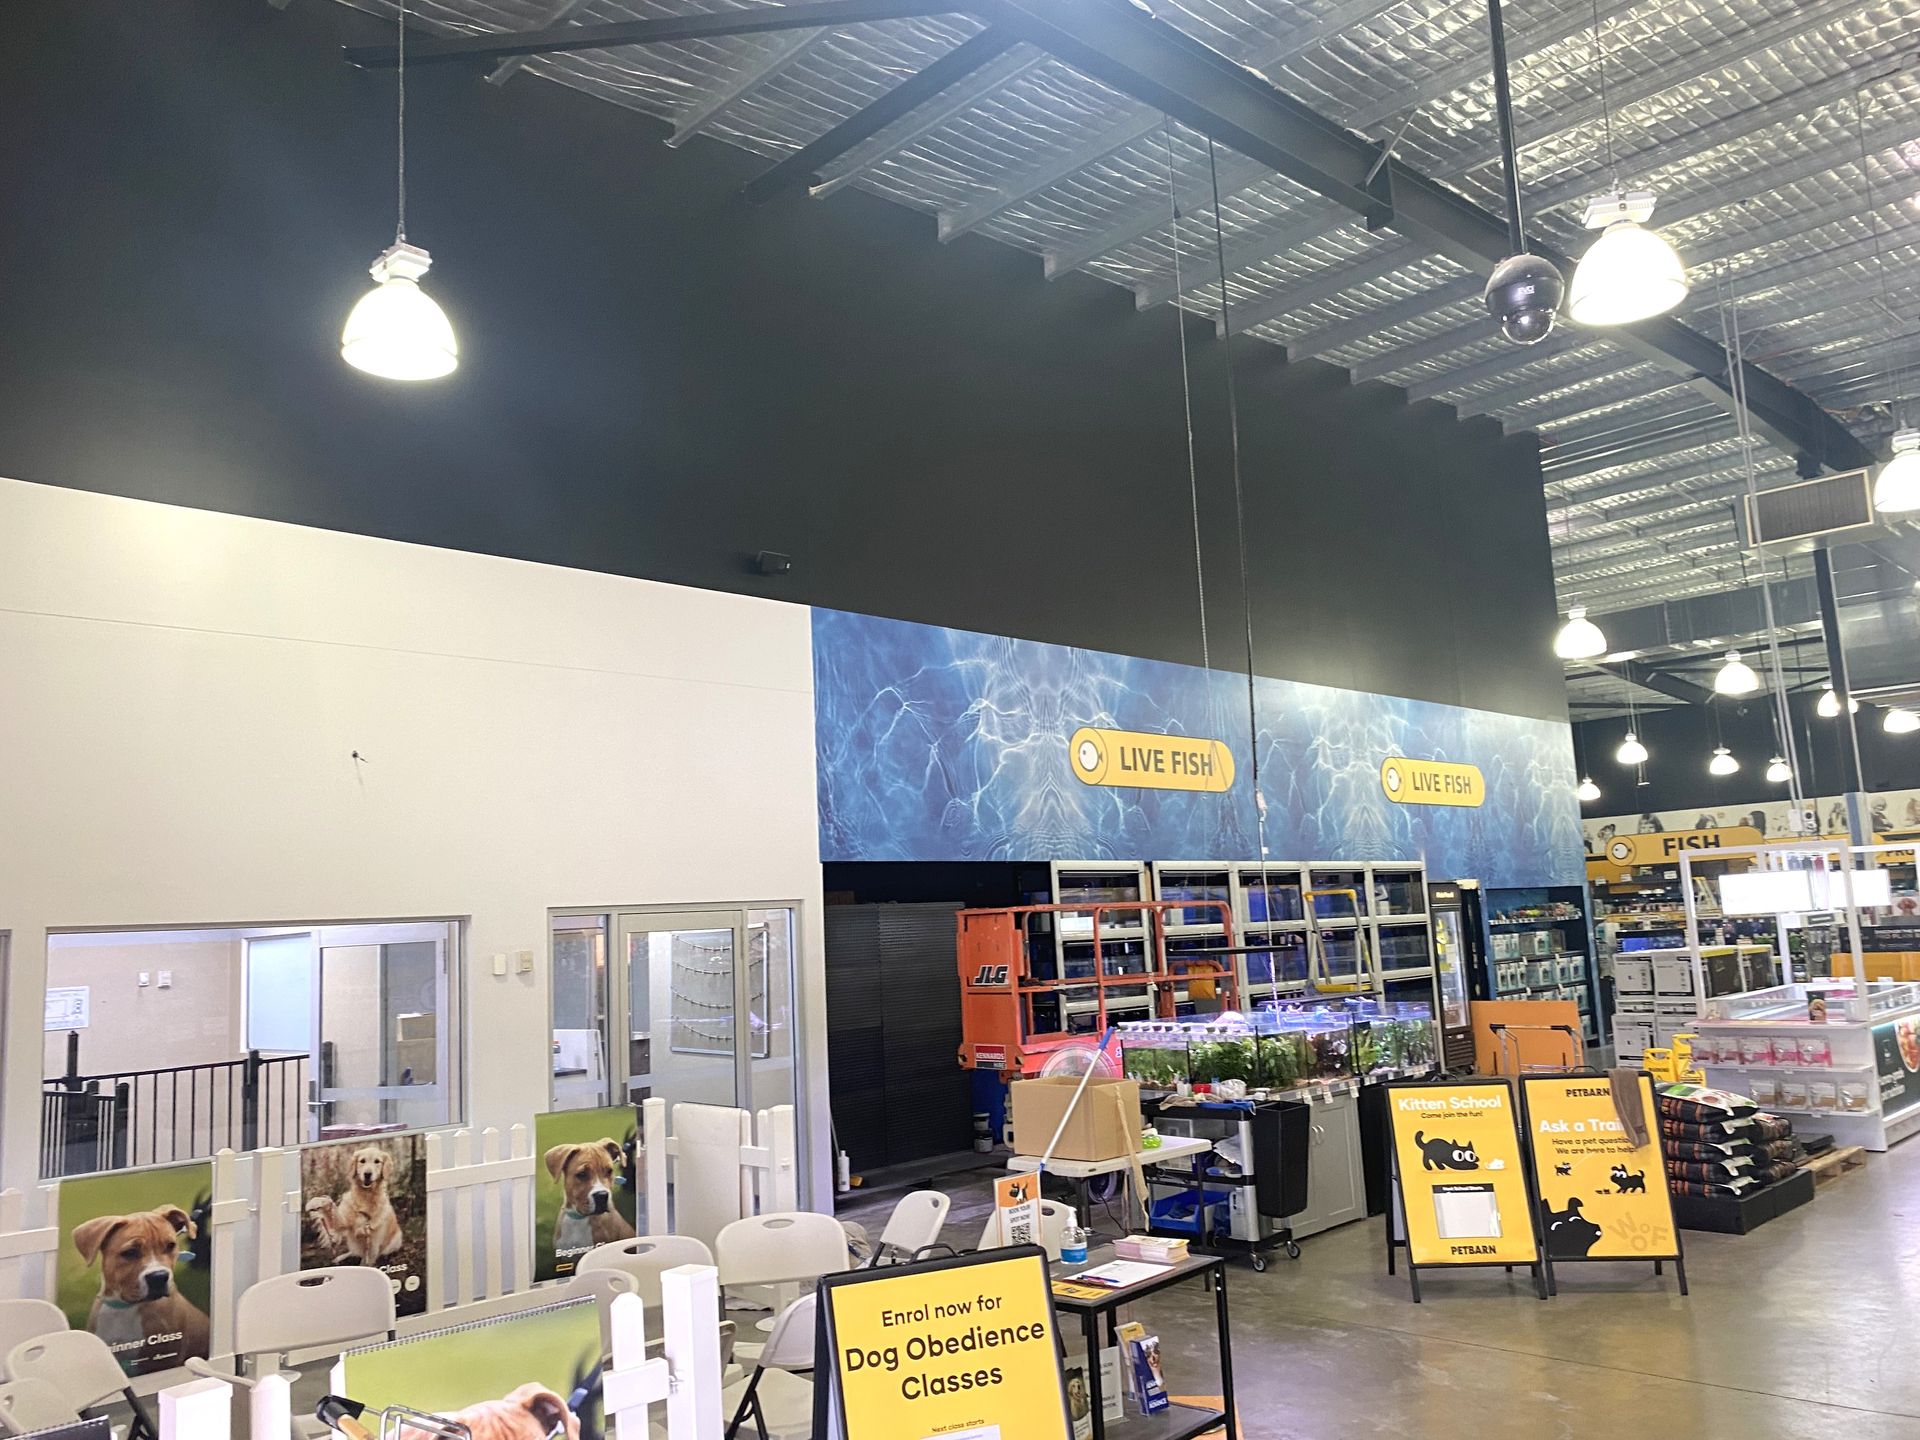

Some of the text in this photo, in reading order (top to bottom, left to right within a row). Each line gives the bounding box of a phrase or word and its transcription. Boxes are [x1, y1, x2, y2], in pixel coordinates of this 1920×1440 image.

[1120, 746, 1213, 777] LIVE FISH
[1412, 771, 1472, 794] LIVE FISH
[1663, 834, 1720, 856] FISH
[973, 964, 1009, 986] JLG
[975, 1052, 1005, 1060] KENNARDS
[1565, 1087, 1611, 1098] PETBARN
[1398, 1095, 1502, 1111] Kitten School
[1443, 1111, 1456, 1119] join
[1539, 1118, 1625, 1133] Ask a Trai
[1582, 1137, 1597, 1146] pet
[1598, 1137, 1630, 1146] questio
[1450, 1245, 1497, 1255] PETBARN
[881, 1294, 1003, 1327] Enrol now for
[147, 1331, 183, 1346] Class
[845, 1322, 1045, 1372] Dog Obedience
[901, 1366, 1004, 1400] Classes
[931, 1424, 948, 1433] Next
